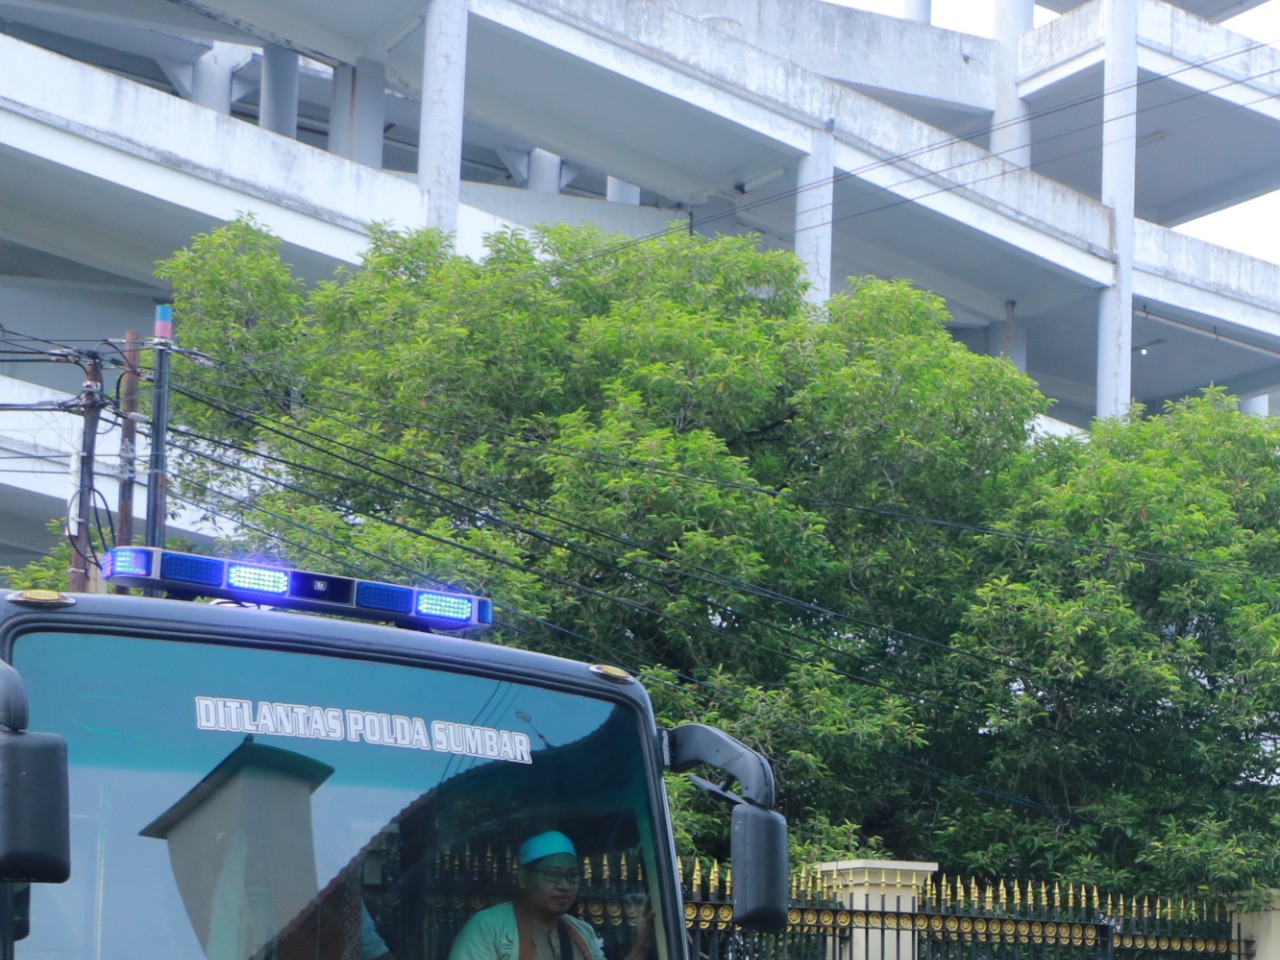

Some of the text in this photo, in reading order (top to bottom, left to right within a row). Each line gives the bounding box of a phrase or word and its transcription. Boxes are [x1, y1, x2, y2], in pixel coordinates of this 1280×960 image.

[196, 696, 532, 764] DITLANTAS POLDA SUMBAR
